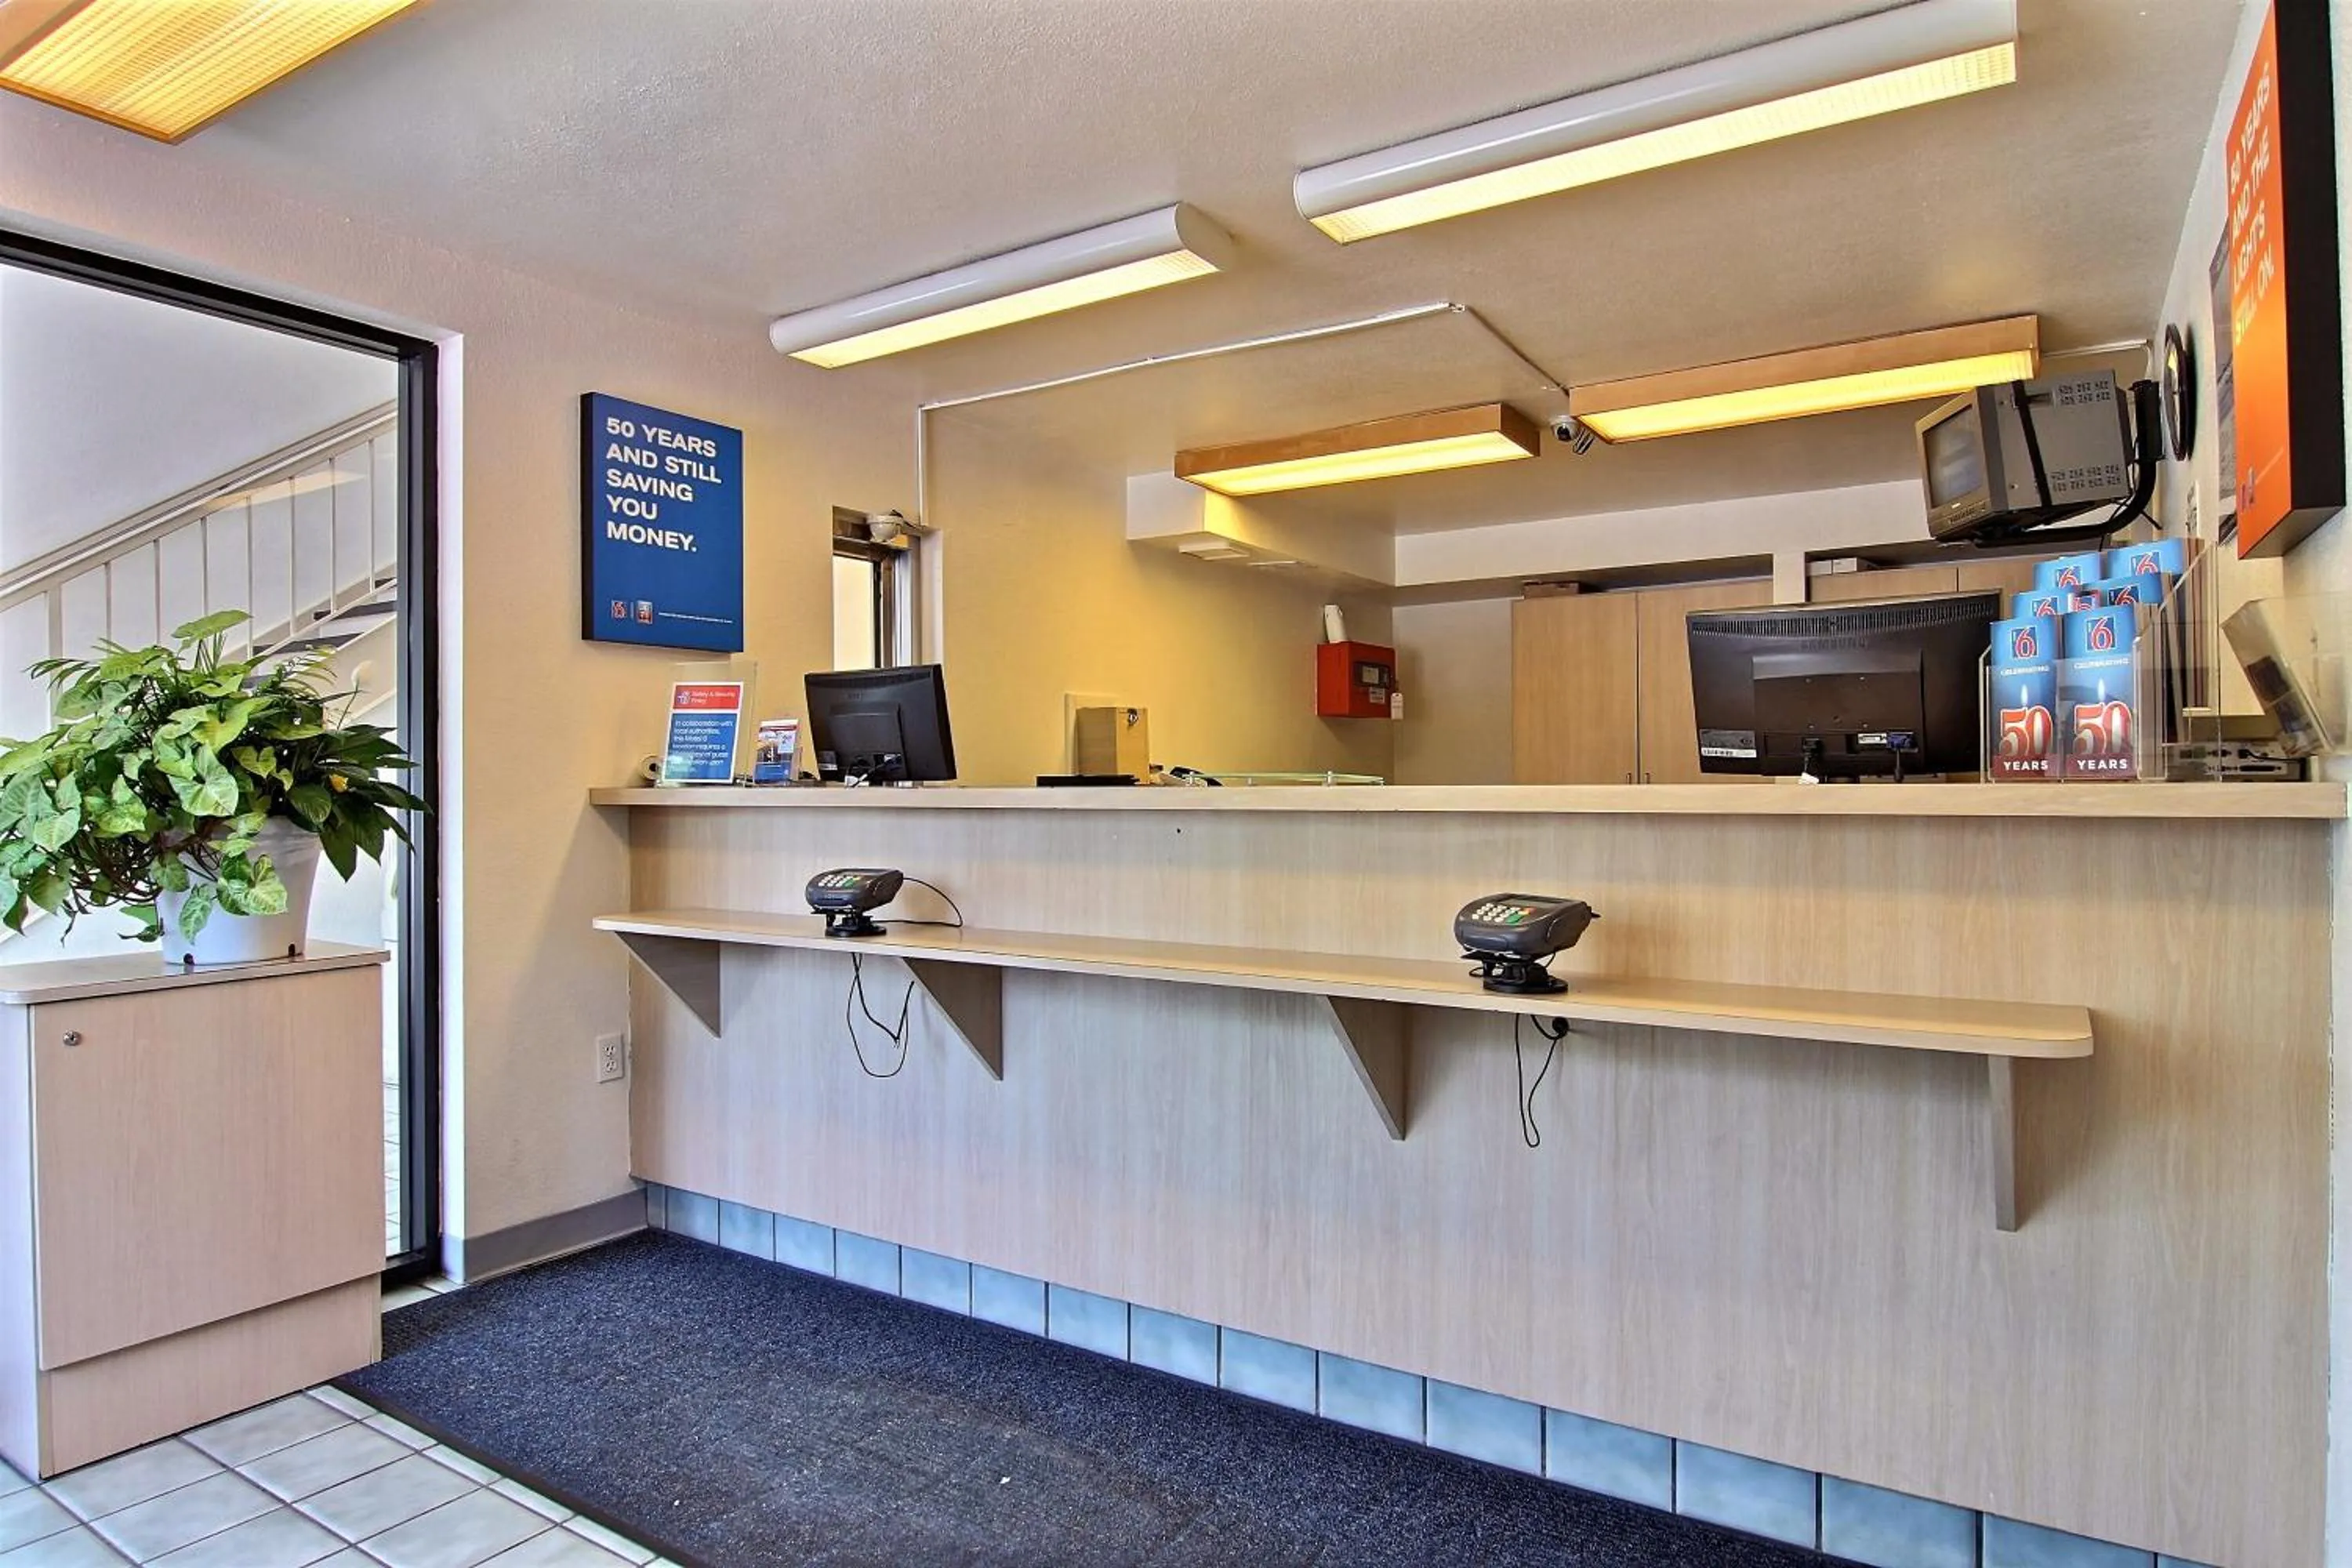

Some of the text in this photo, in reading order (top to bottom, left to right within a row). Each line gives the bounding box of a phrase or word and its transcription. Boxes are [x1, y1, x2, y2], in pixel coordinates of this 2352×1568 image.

[2241, 62, 2270, 164] YEARS
[2251, 125, 2270, 197] THE
[2234, 199, 2266, 295] LIGHTS
[606, 416, 717, 458] 50 YEARS
[606, 442, 722, 484] AND STILL
[606, 468, 694, 503] SAVING
[606, 493, 659, 521] YOU
[606, 520, 697, 553] MONEY.
[2015, 626, 2037, 659] 6
[2090, 615, 2113, 651] 6
[1999, 704, 2053, 757] 50
[2073, 700, 2132, 757] 50
[2003, 760, 2049, 771] YEARS
[2077, 758, 2128, 770] YEARS
